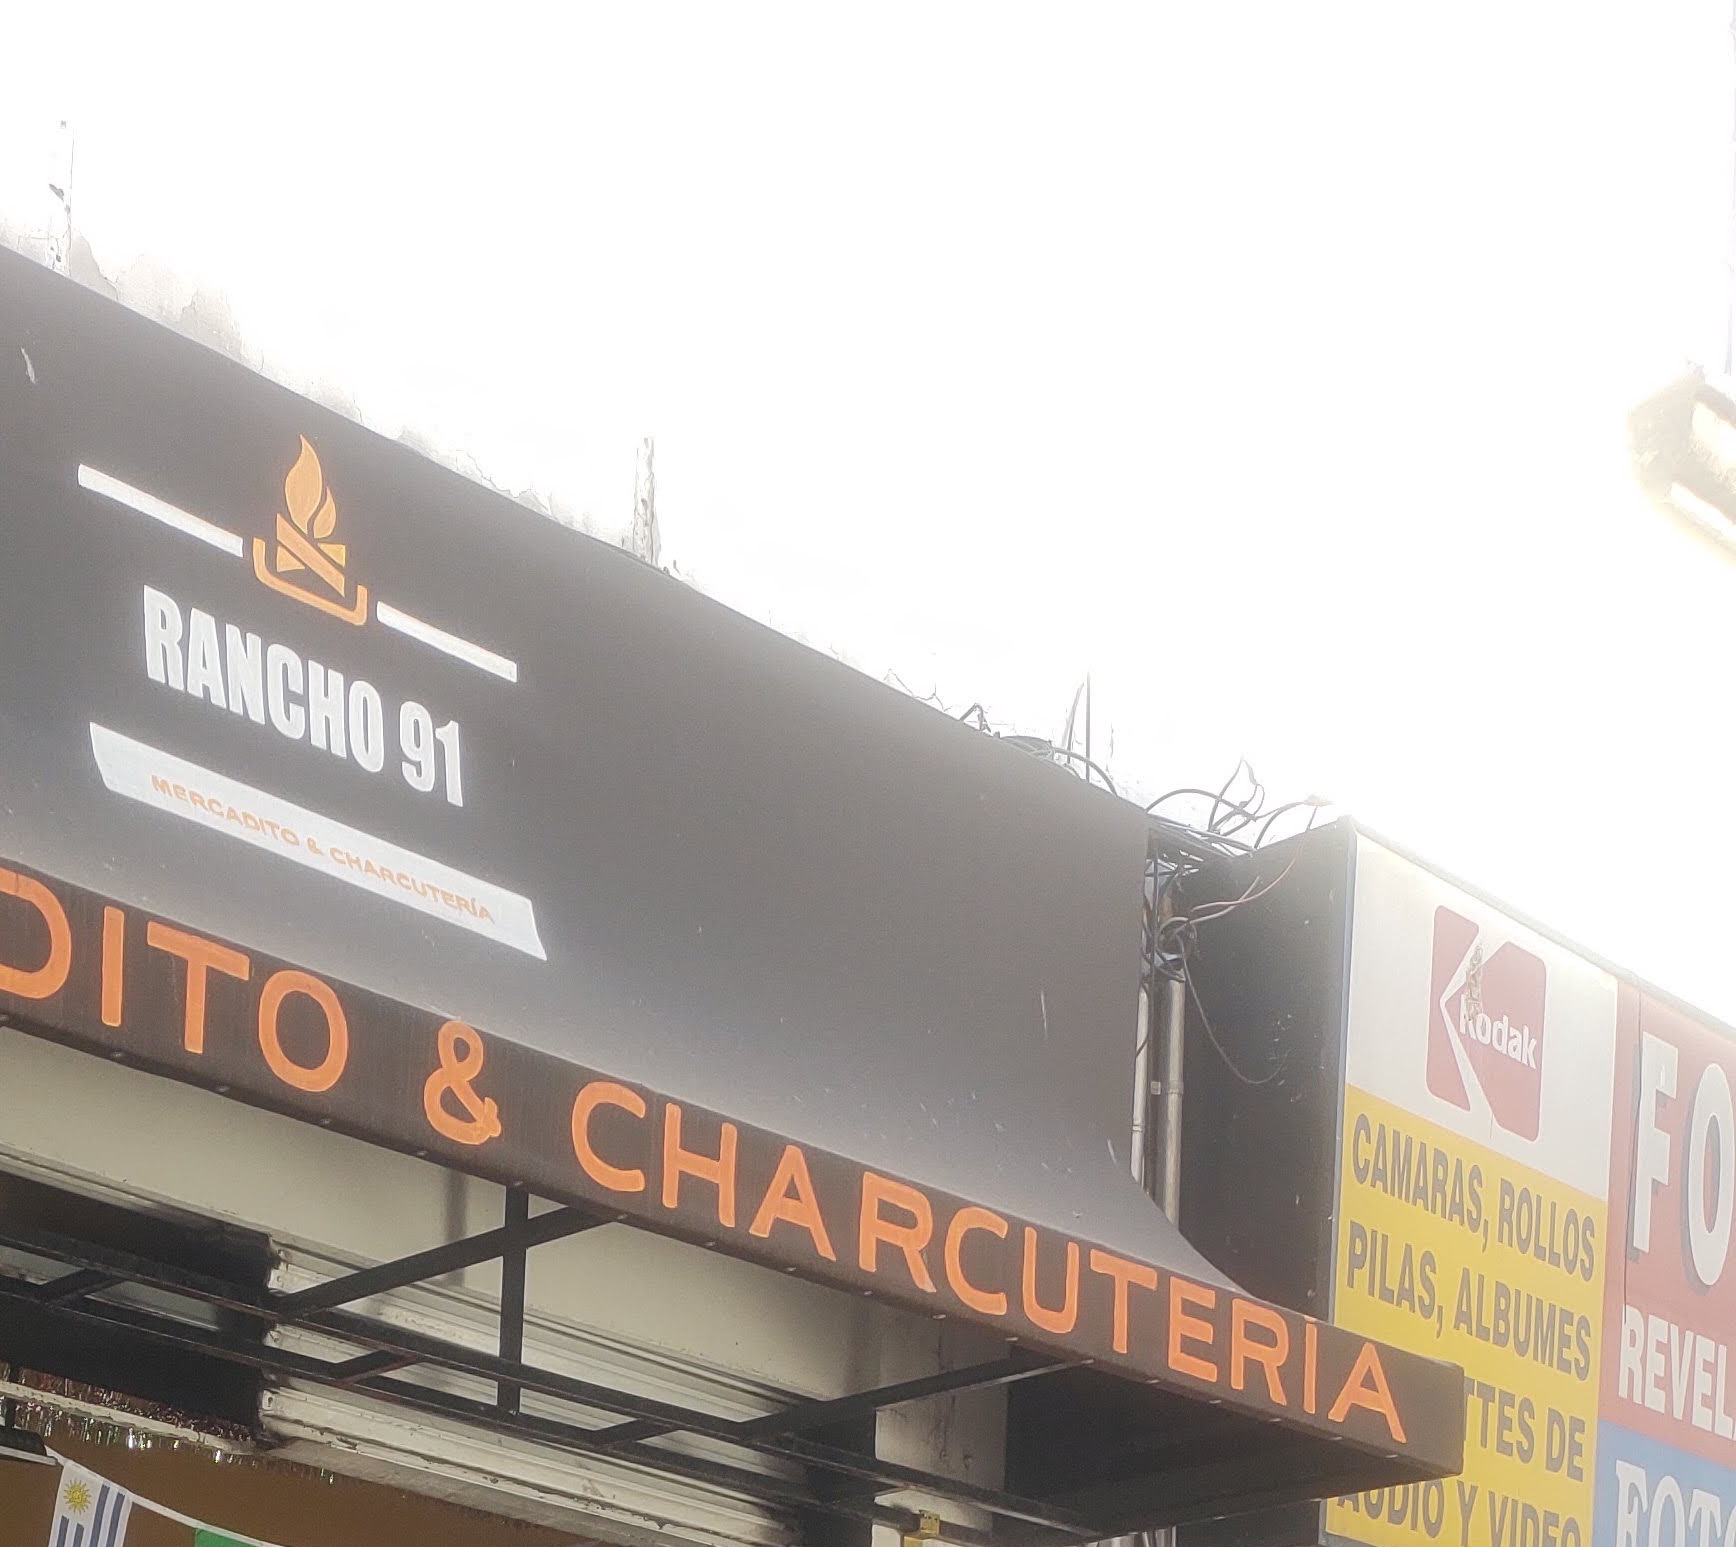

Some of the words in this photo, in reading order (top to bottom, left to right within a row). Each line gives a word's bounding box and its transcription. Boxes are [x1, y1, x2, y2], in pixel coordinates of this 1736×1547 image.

[143, 584, 385, 773] RANCHO
[398, 701, 463, 807] 91
[151, 774, 301, 846] MERCADITO
[308, 837, 324, 856] &
[423, 1020, 502, 1145] &
[1459, 994, 1537, 1070] Kodak
[1352, 1113, 1489, 1253] CAMARAS,
[1498, 1177, 1595, 1281] ROLLOS
[1346, 1220, 1443, 1338] PILAS,
[1453, 1266, 1592, 1382] ALBUMES
[1546, 1407, 1585, 1482] DE
[1338, 1478, 1445, 1539] UDIO
[1456, 1480, 1478, 1547] Y
